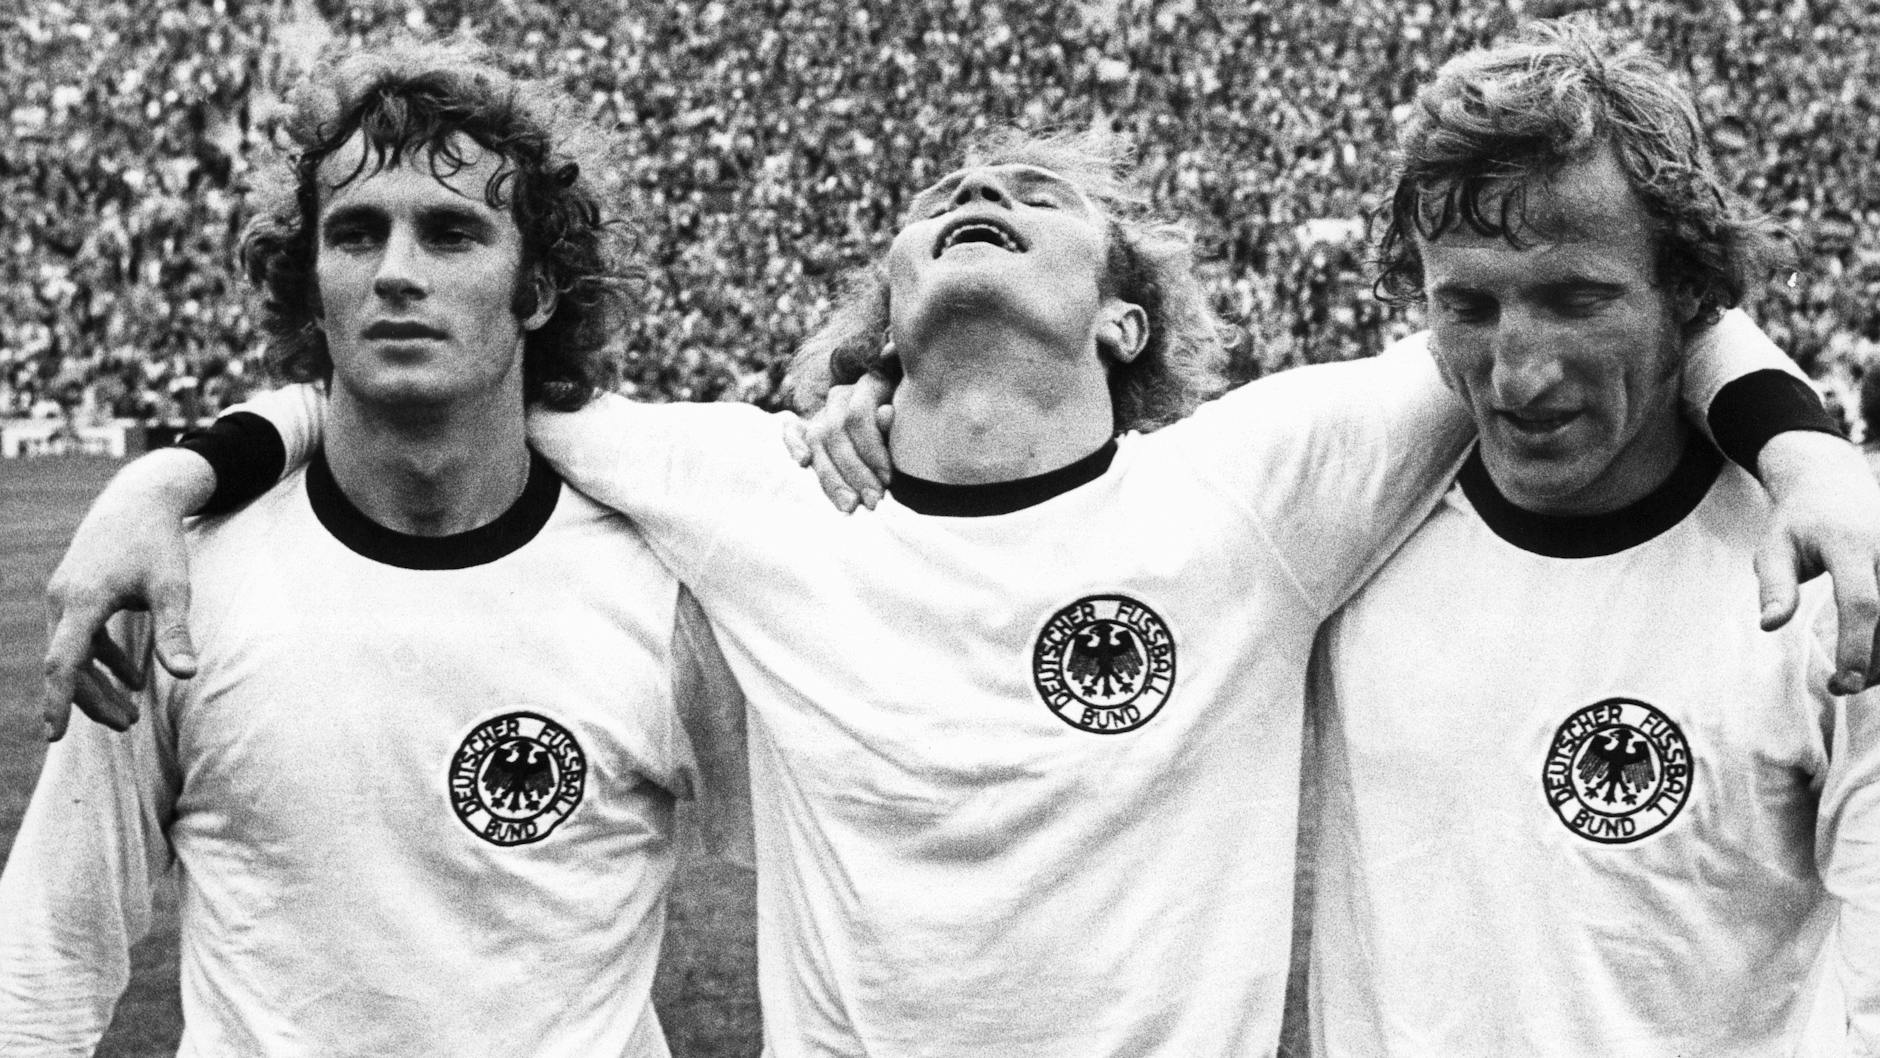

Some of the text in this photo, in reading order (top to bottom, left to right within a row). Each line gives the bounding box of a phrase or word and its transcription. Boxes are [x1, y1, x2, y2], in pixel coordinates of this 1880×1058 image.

[1037, 602, 1172, 709] DEUTSCHER FUSSBALL
[1080, 704, 1140, 728] BUND
[452, 719, 583, 817] DEUTSCHER FUSSBALL
[1549, 705, 1687, 816] DEUTSCHER FUSSBALL
[485, 818, 537, 840] BUND
[1571, 809, 1635, 837] BUND
